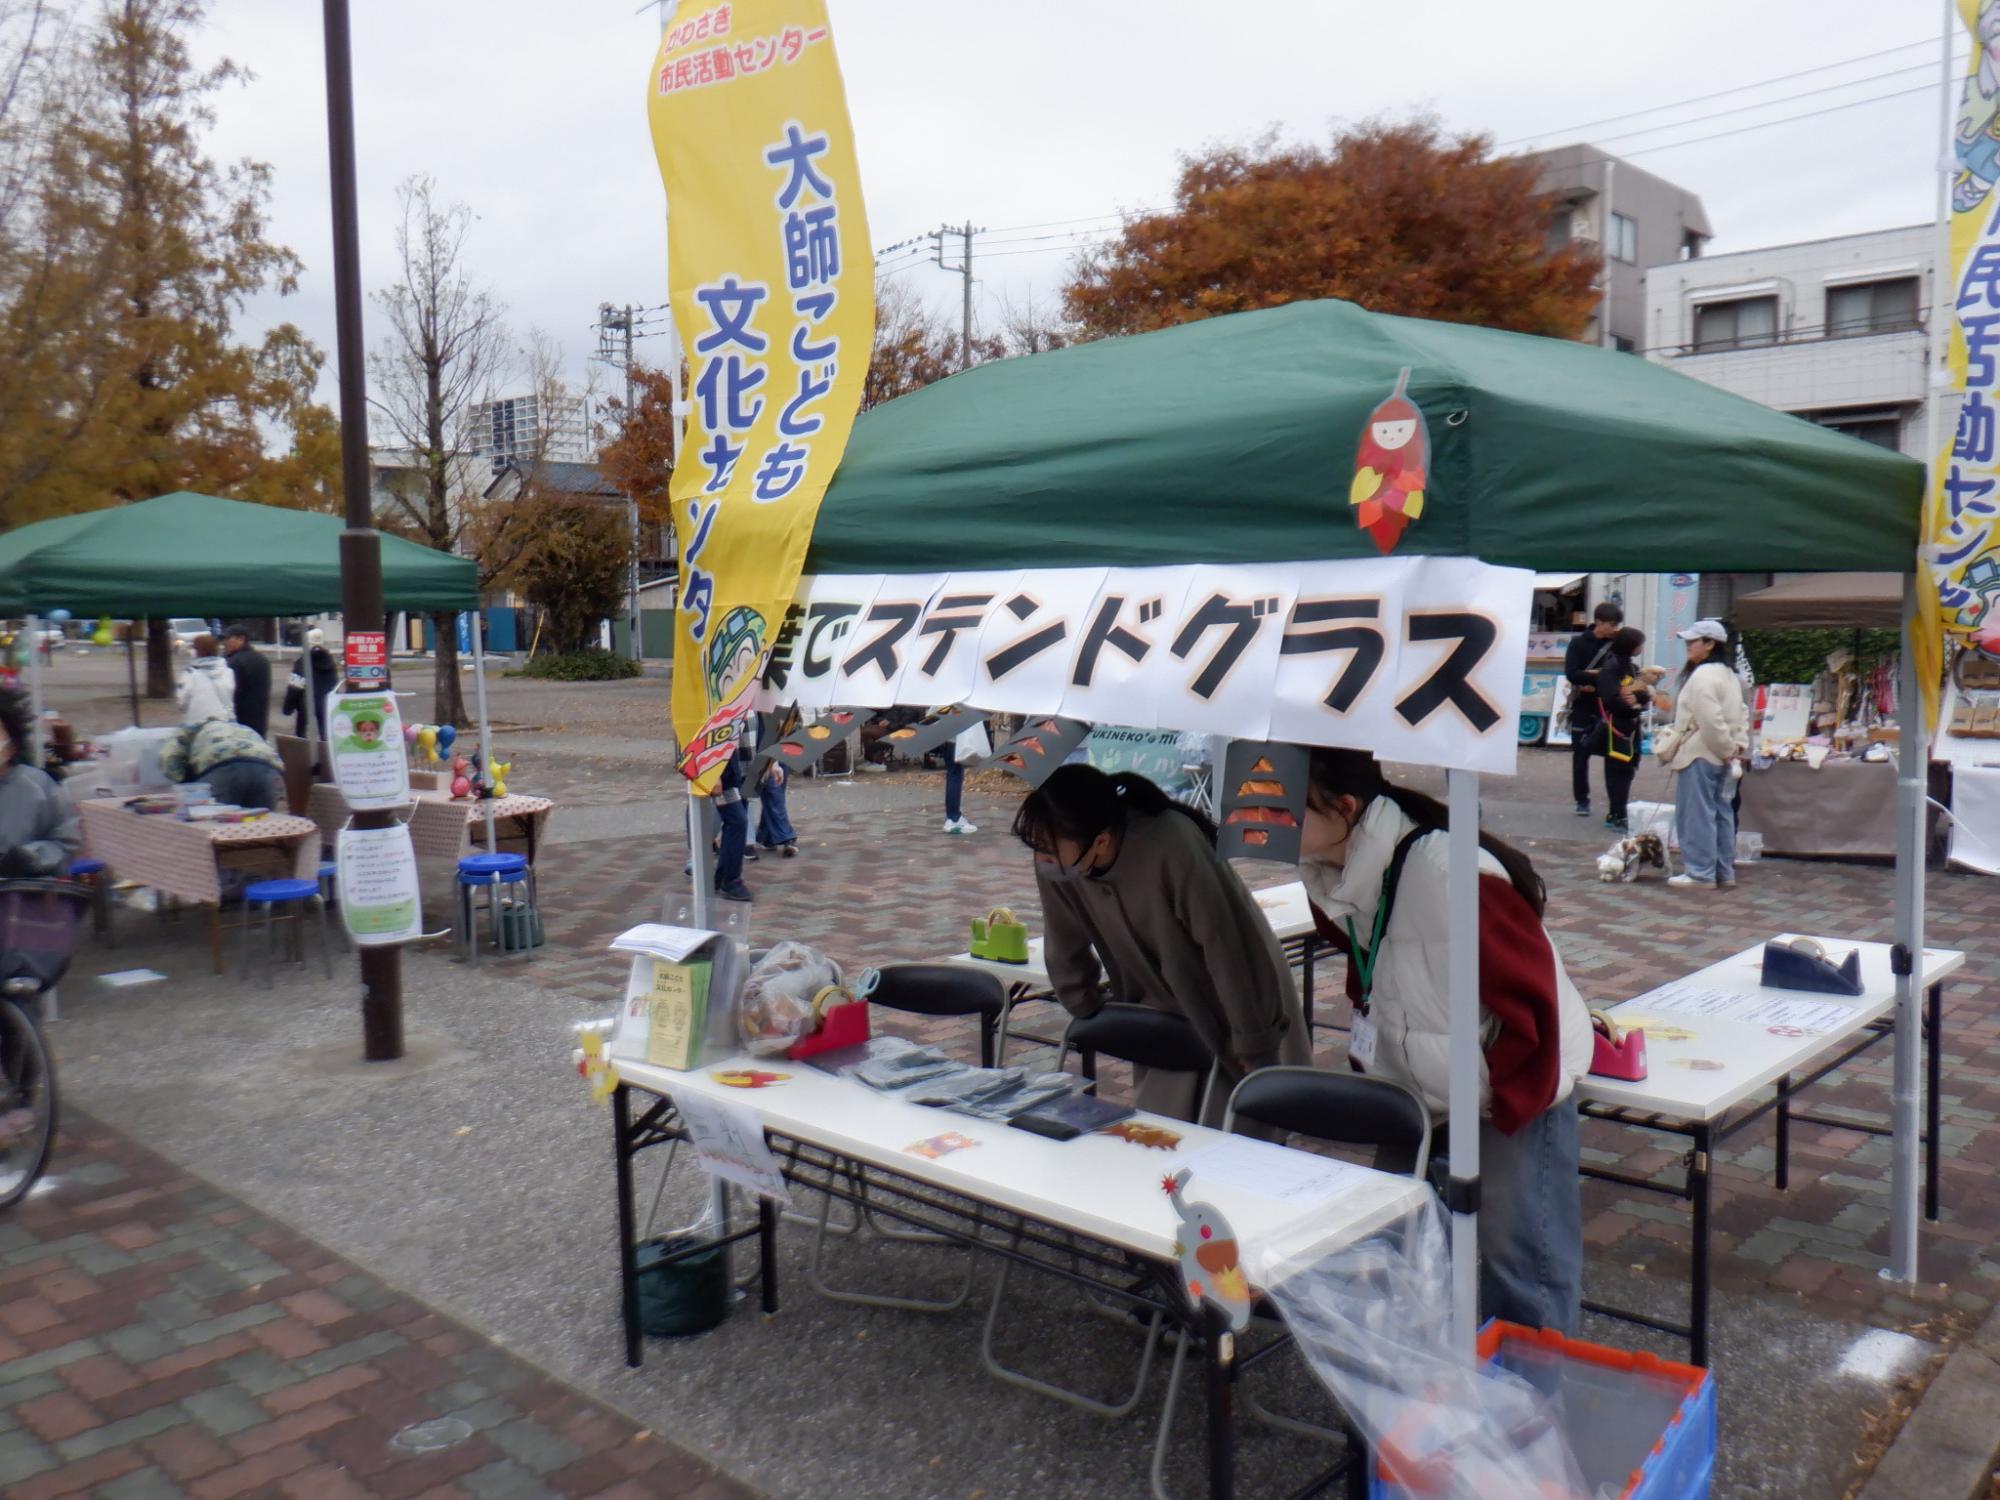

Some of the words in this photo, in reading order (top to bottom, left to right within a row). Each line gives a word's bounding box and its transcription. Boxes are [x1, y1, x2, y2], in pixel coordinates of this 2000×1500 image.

[660, 29, 827, 93] 市民活動センター
[665, 6, 731, 54] かわさき
[756, 125, 838, 499] 大師こども
